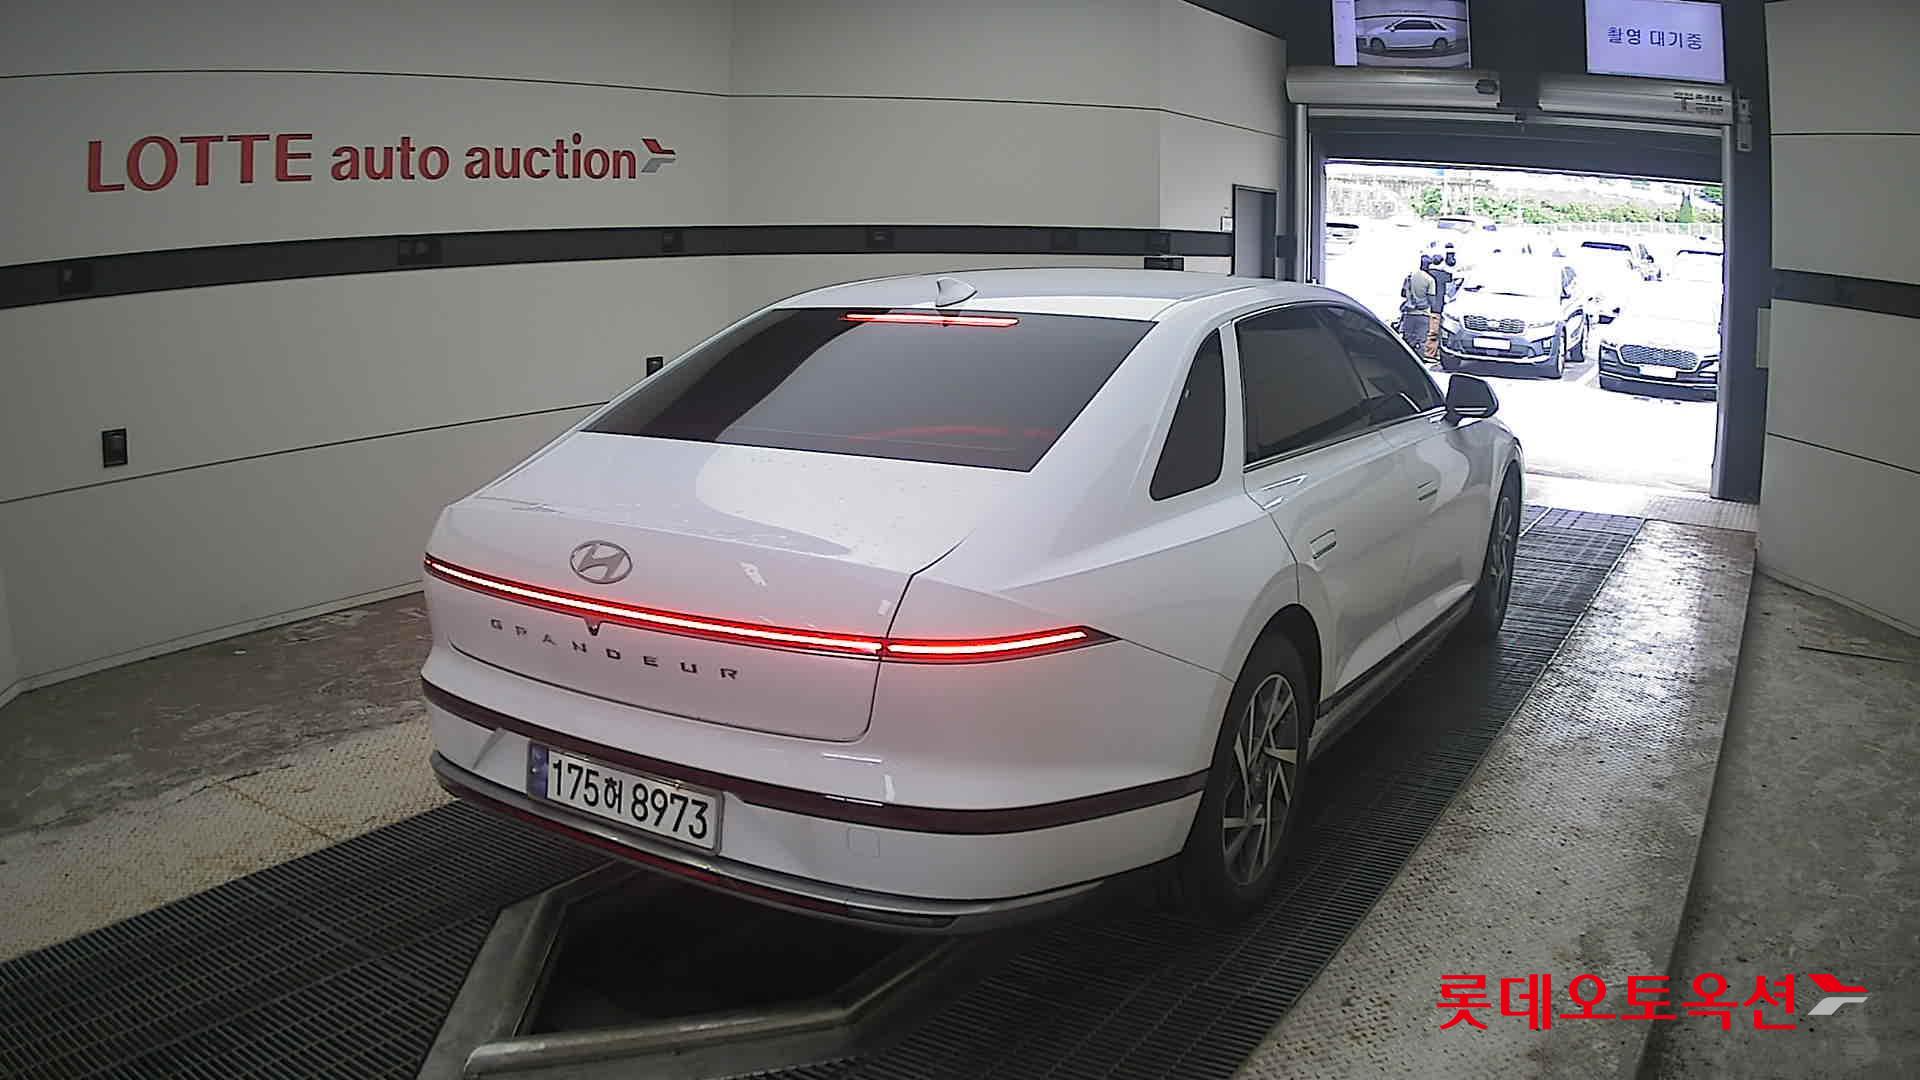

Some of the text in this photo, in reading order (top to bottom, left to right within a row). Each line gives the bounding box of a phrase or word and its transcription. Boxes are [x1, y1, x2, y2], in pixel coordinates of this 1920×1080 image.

[1607, 26, 1703, 50] 촬영 대기중
[88, 132, 637, 193] LOTTE auto auction
[490, 618, 738, 680] GRANDEUR
